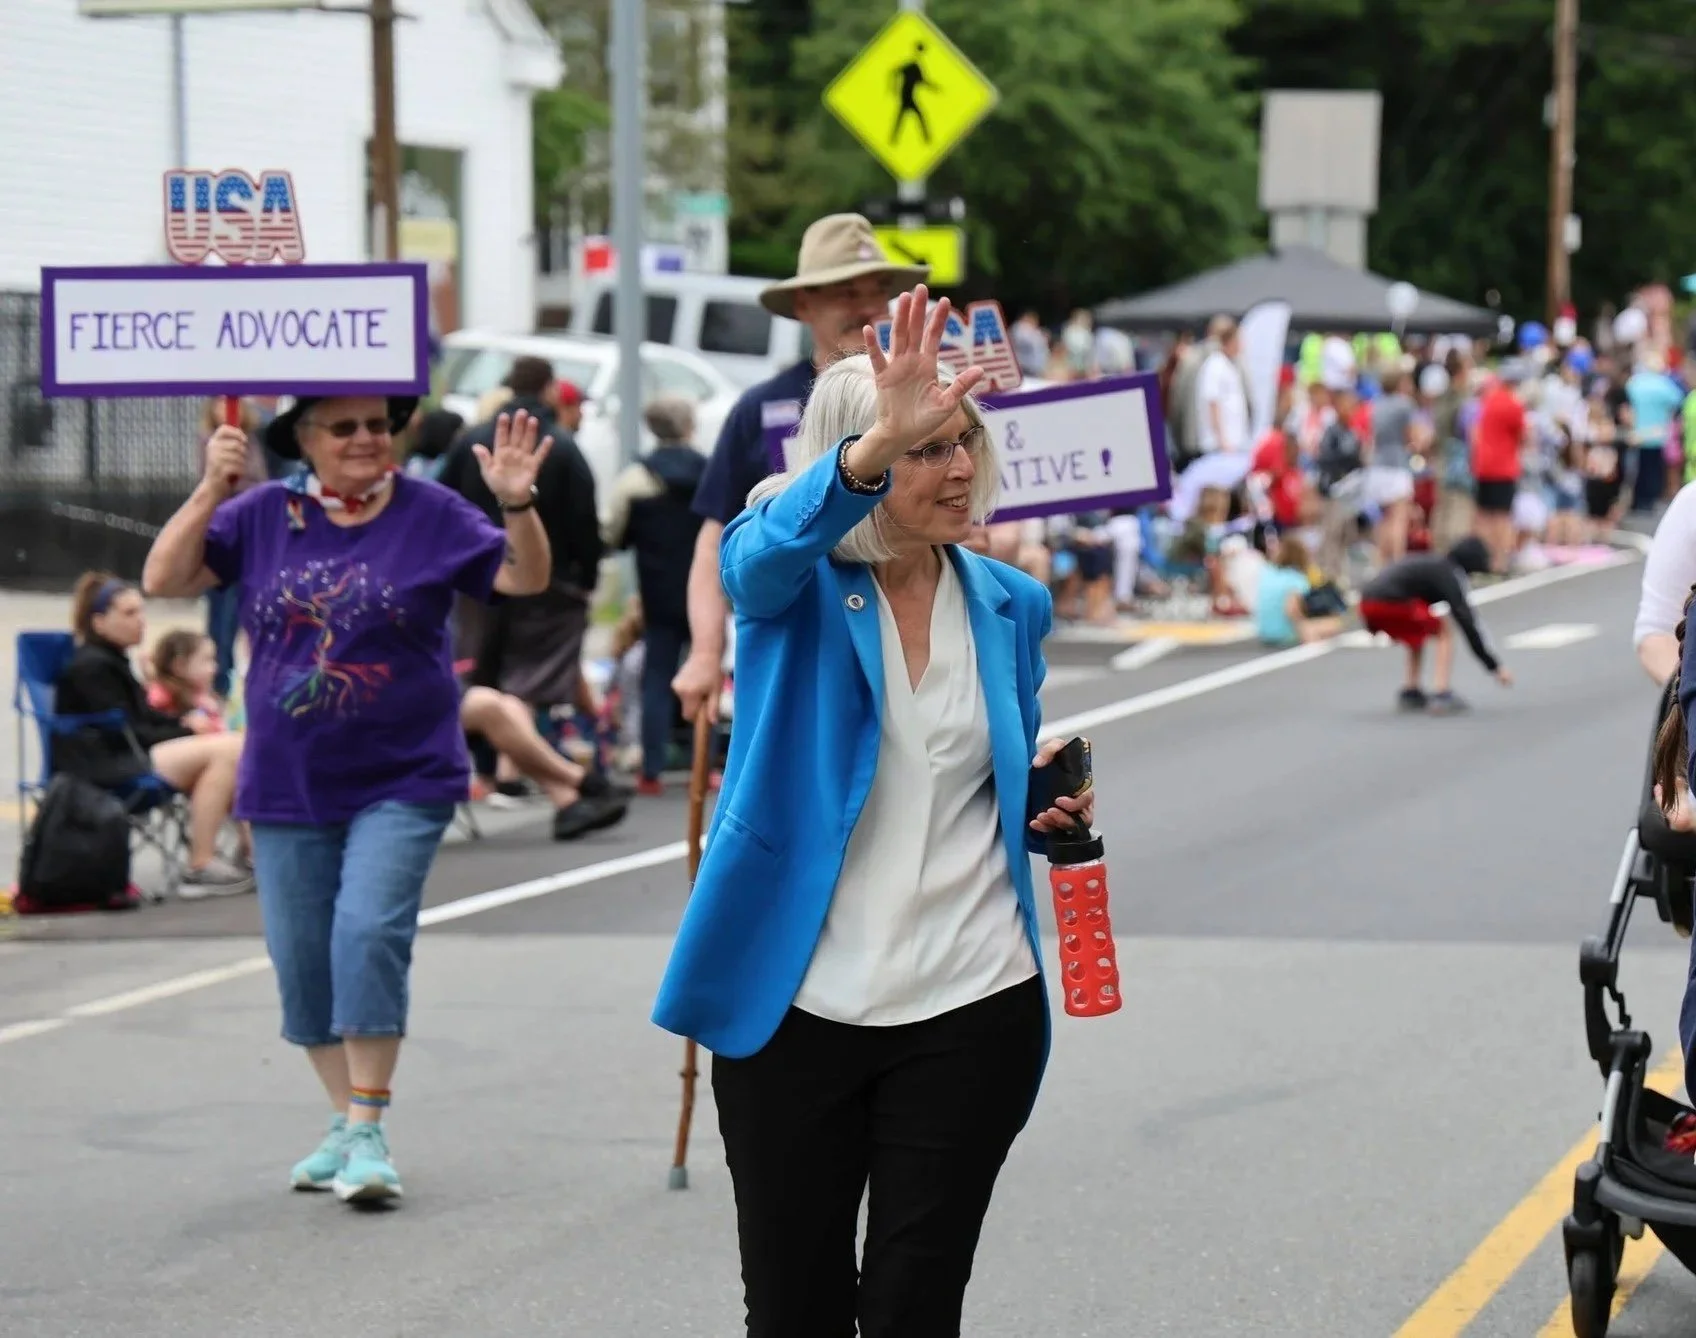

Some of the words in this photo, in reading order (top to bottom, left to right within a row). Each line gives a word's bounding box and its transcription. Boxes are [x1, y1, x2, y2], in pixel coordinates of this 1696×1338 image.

[167, 171, 302, 260] USA
[69, 311, 196, 351] FIERCE
[216, 308, 388, 349] ADVOCATE
[1005, 420, 1026, 451] &
